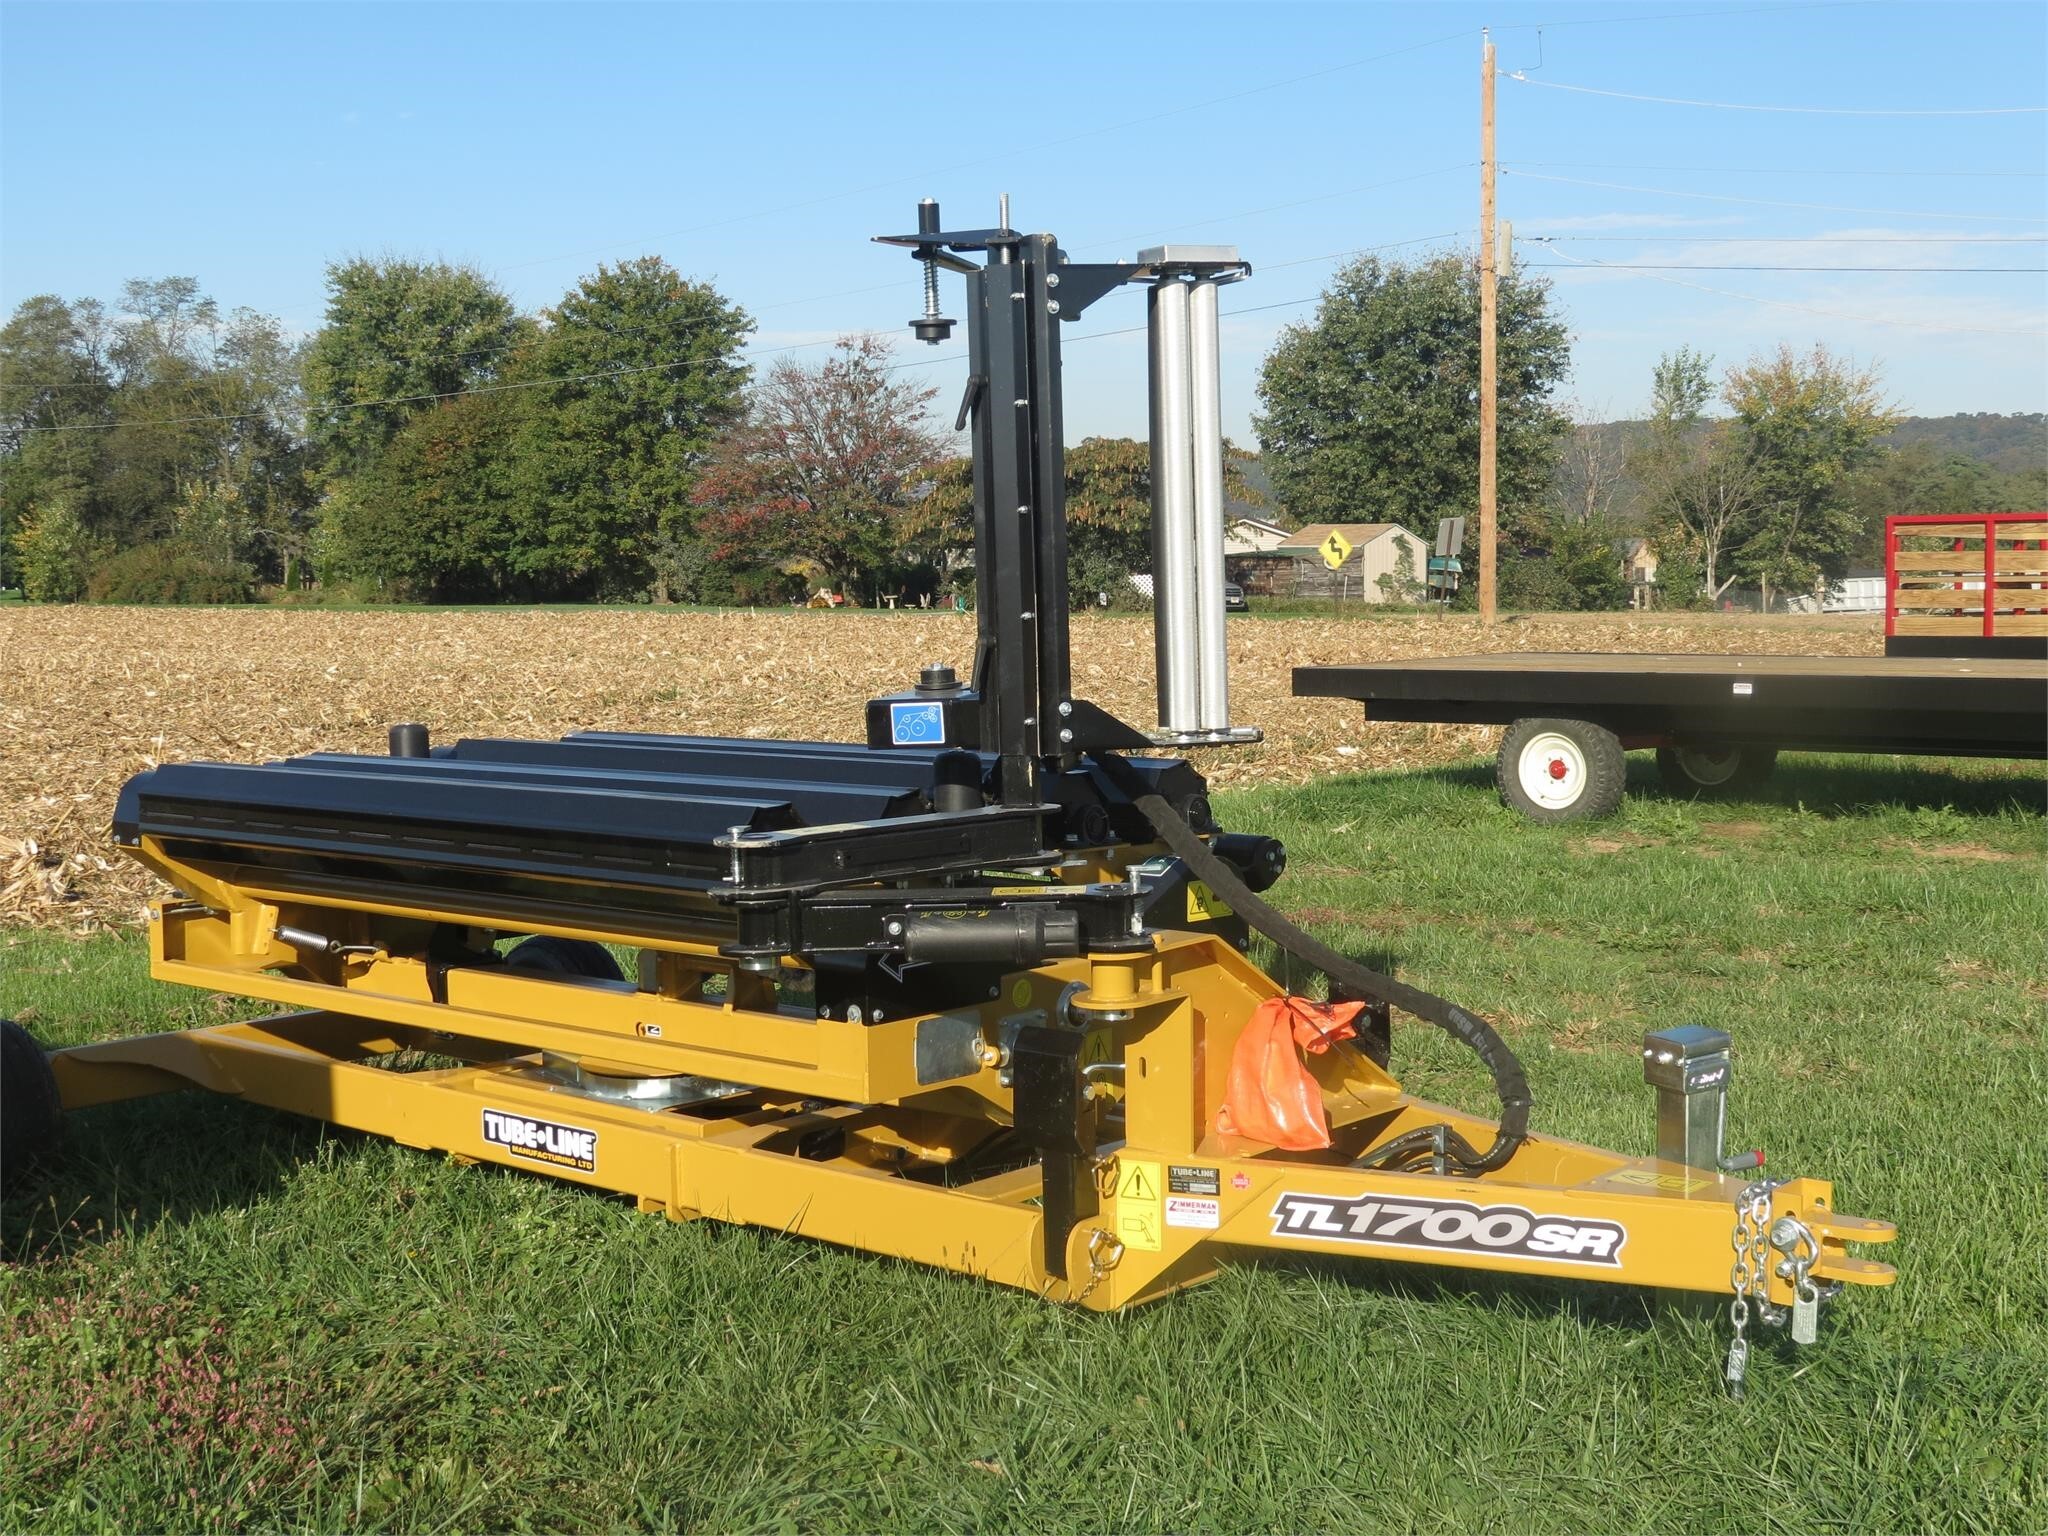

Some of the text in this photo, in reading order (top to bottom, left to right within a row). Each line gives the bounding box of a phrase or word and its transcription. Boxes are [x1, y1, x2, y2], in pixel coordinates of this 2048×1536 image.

[512, 1145, 592, 1169] MANUFACTURING LTD
[1168, 1200, 1216, 1211] ZIMMERMAN
